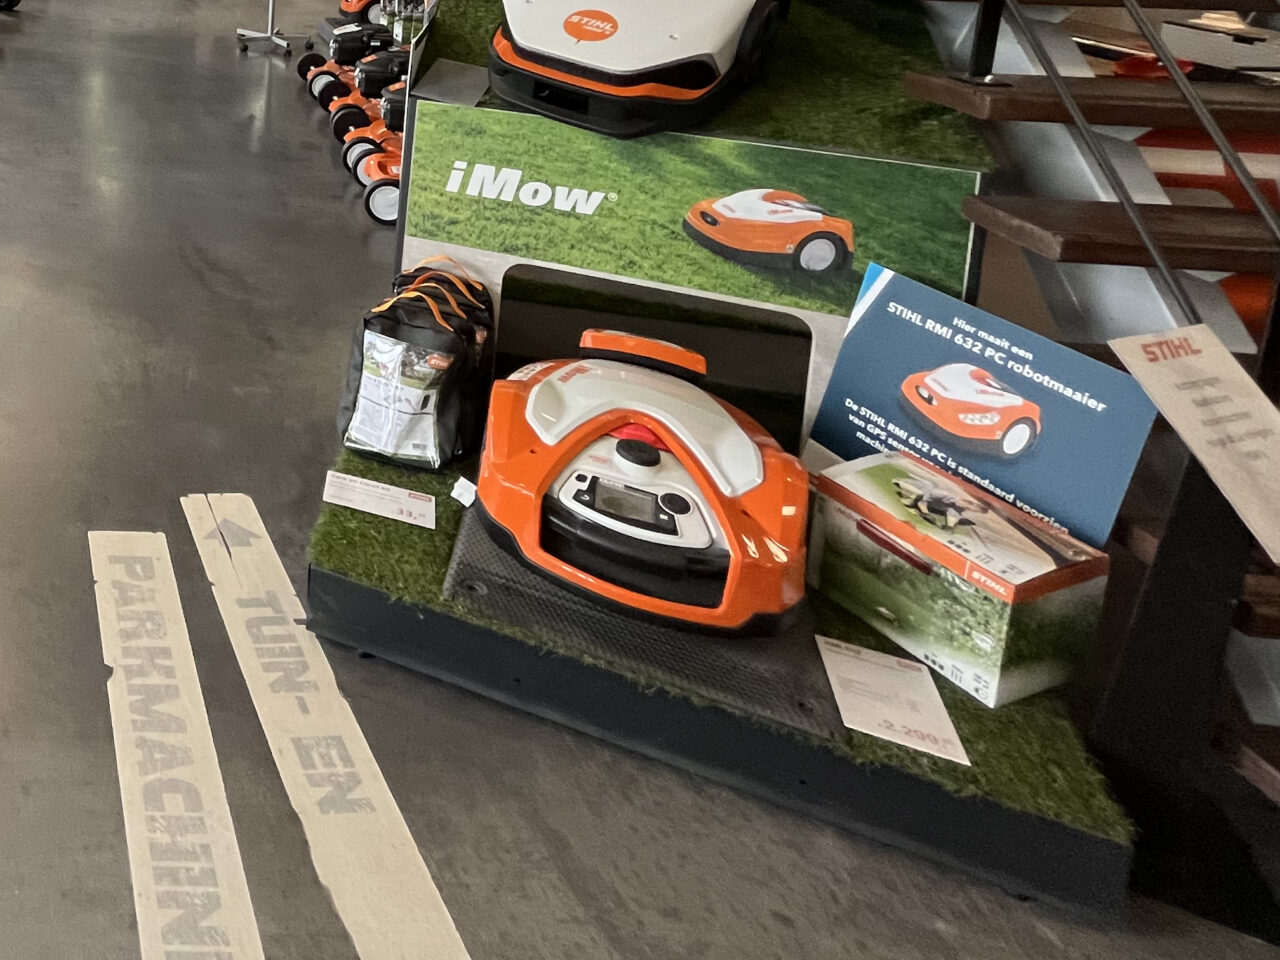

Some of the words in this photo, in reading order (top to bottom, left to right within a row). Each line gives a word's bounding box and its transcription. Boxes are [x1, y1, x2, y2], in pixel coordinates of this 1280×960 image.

[568, 15, 615, 33] STIHL
[886, 301, 924, 327] STIHL
[924, 318, 953, 340] RMI
[953, 333, 983, 355] 632
[983, 346, 1007, 365] PC
[1006, 360, 1108, 412] robotmaaier
[952, 316, 977, 335] Hier
[977, 329, 1010, 350] maait
[1010, 345, 1034, 361] een
[1141, 337, 1203, 364] STIHL
[848, 413, 866, 429] van
[866, 423, 888, 441] GPS
[844, 397, 859, 412] De
[859, 406, 886, 429] STIHL
[886, 422, 908, 441] RMI
[908, 436, 931, 454] 632
[930, 447, 948, 463] PC
[946, 457, 958, 470] is
[957, 465, 1016, 503] standaard
[971, 570, 1008, 596] STIHL
[235, 589, 320, 715] TUIN-
[290, 735, 377, 816] EN
[107, 554, 235, 960] PARKMACHIN
